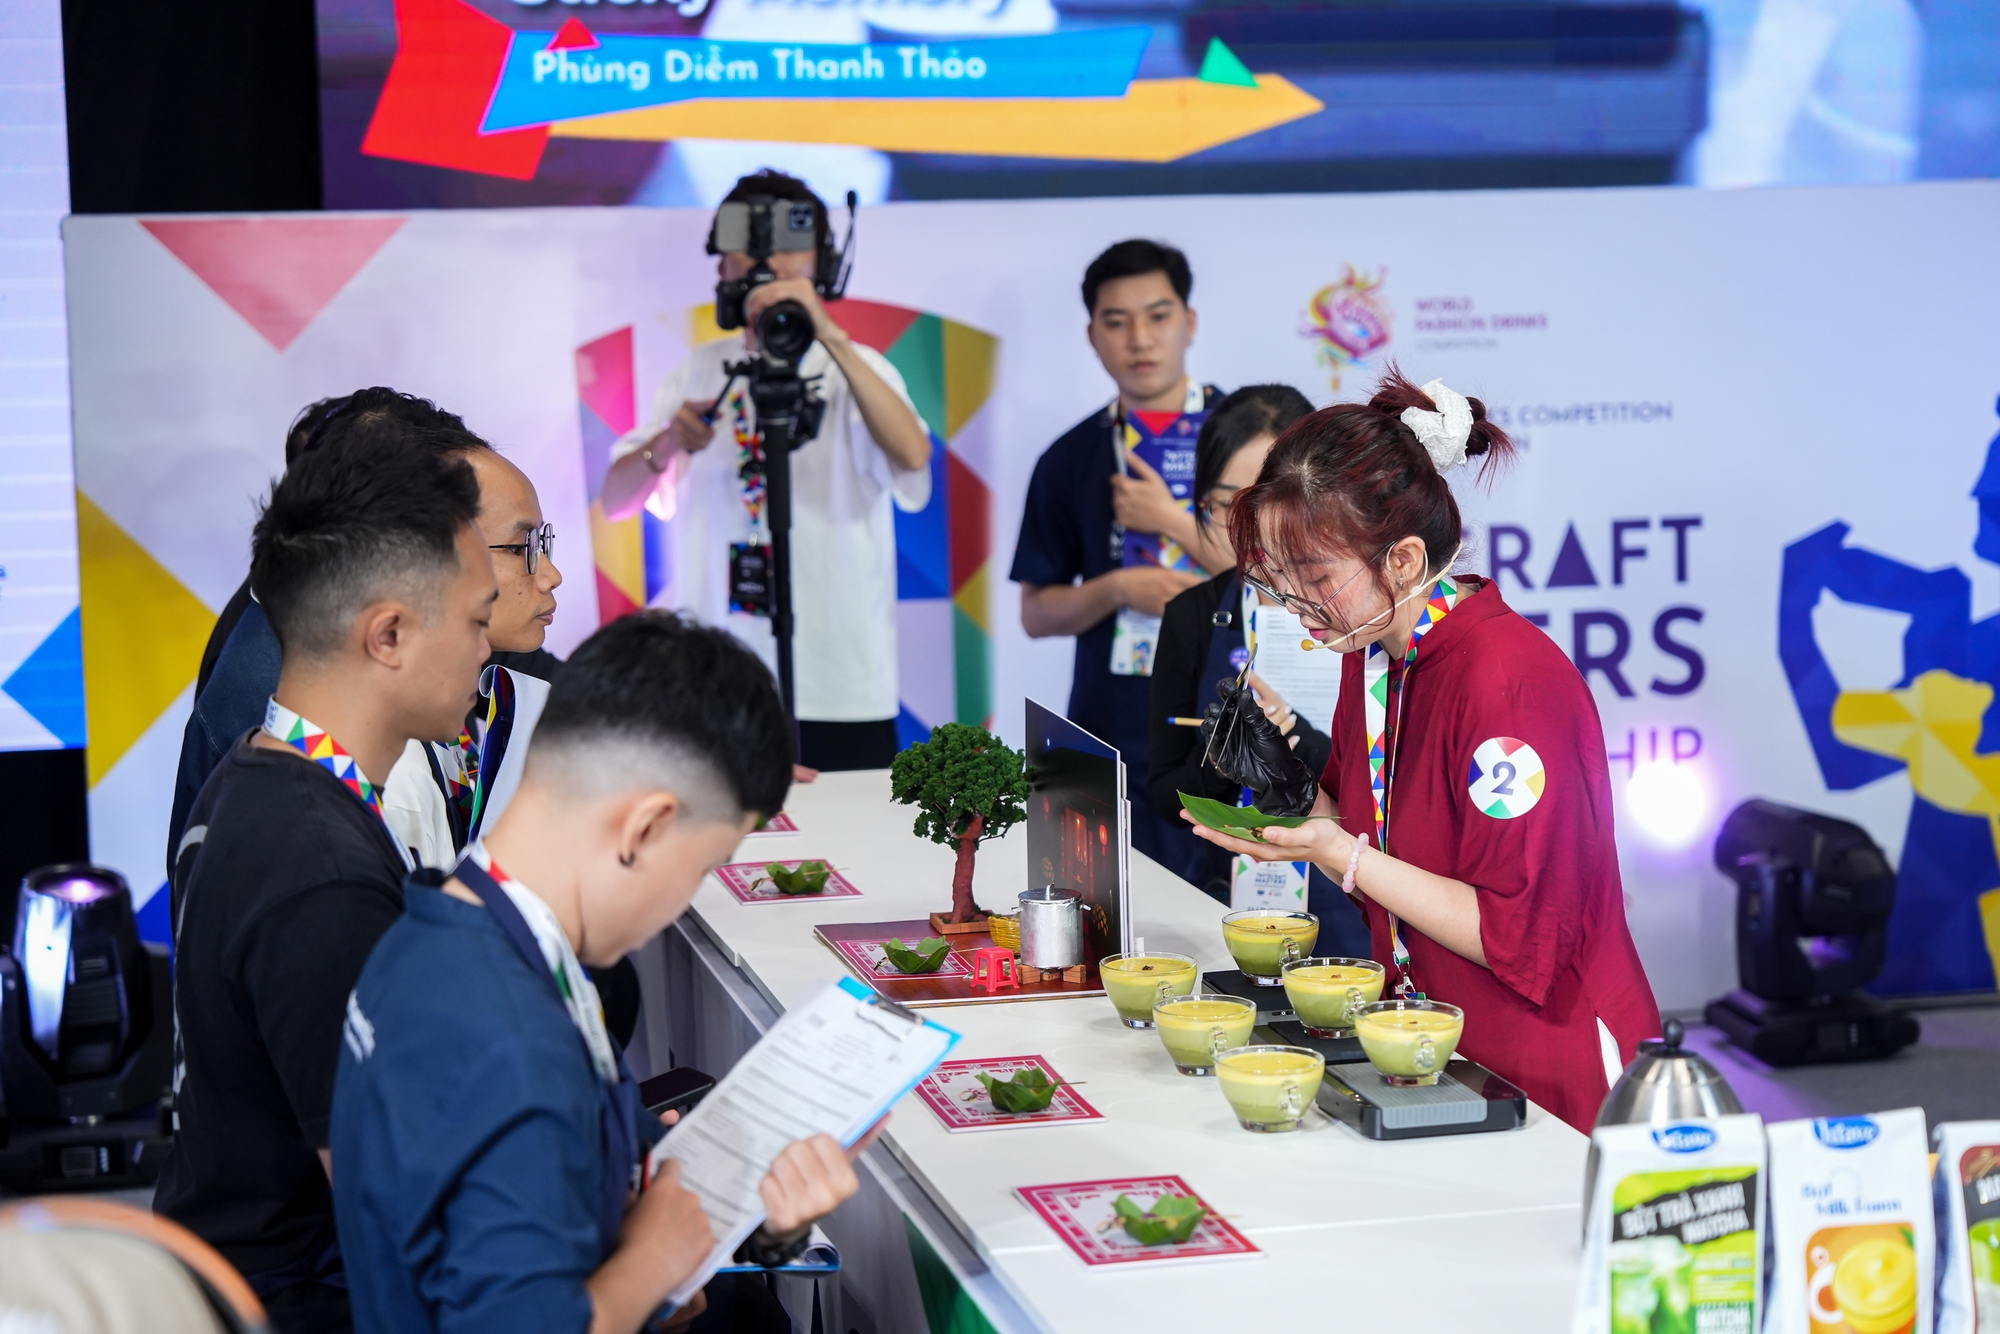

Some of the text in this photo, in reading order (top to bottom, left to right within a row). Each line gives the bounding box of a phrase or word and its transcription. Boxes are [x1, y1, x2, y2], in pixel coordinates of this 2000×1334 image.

[533, 50, 650, 90] Phùng
[773, 48, 884, 80] Thanh
[899, 46, 988, 80] Thảo
[1492, 313, 1548, 330] DRINKS
[1518, 402, 1674, 427] COMPETITION
[1487, 517, 1703, 589] RAFT
[1491, 761, 1517, 796] 2
